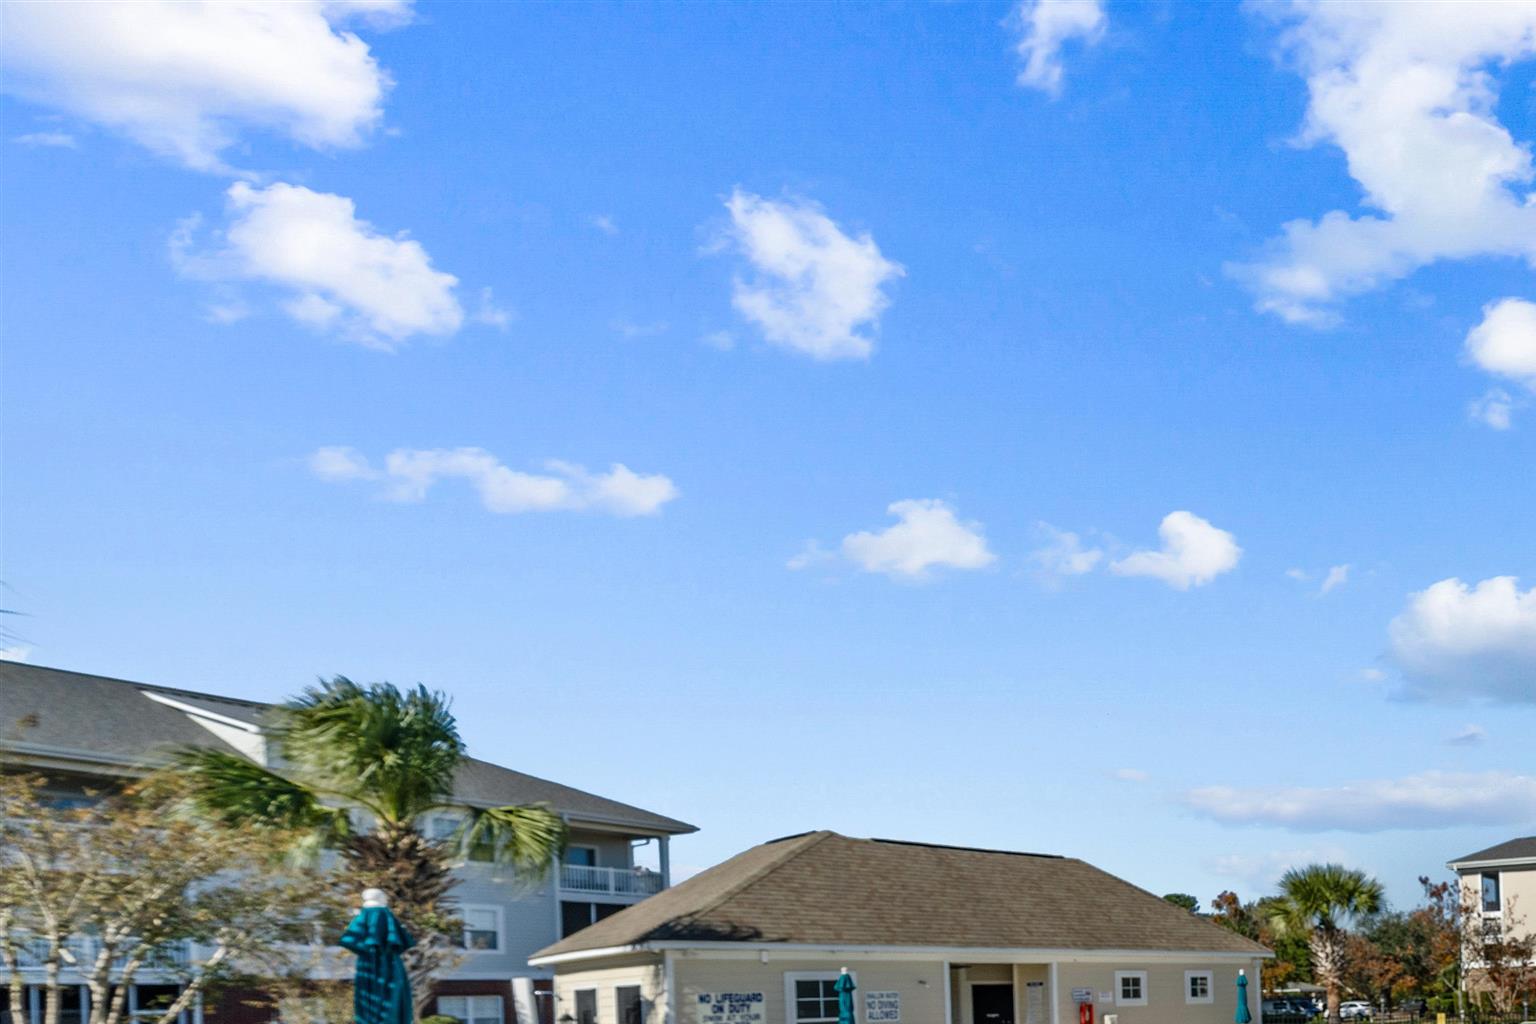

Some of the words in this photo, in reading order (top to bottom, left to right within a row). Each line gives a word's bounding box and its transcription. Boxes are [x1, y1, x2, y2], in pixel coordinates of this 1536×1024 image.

[698, 993, 711, 1004] NO
[715, 992, 763, 1004] LIFEGUARD
[712, 1004, 724, 1014] ON
[728, 1003, 751, 1014] DUTY
[866, 1000, 876, 1010] NO
[878, 1000, 899, 1010] DIVING
[868, 1010, 899, 1020] ALLOWED
